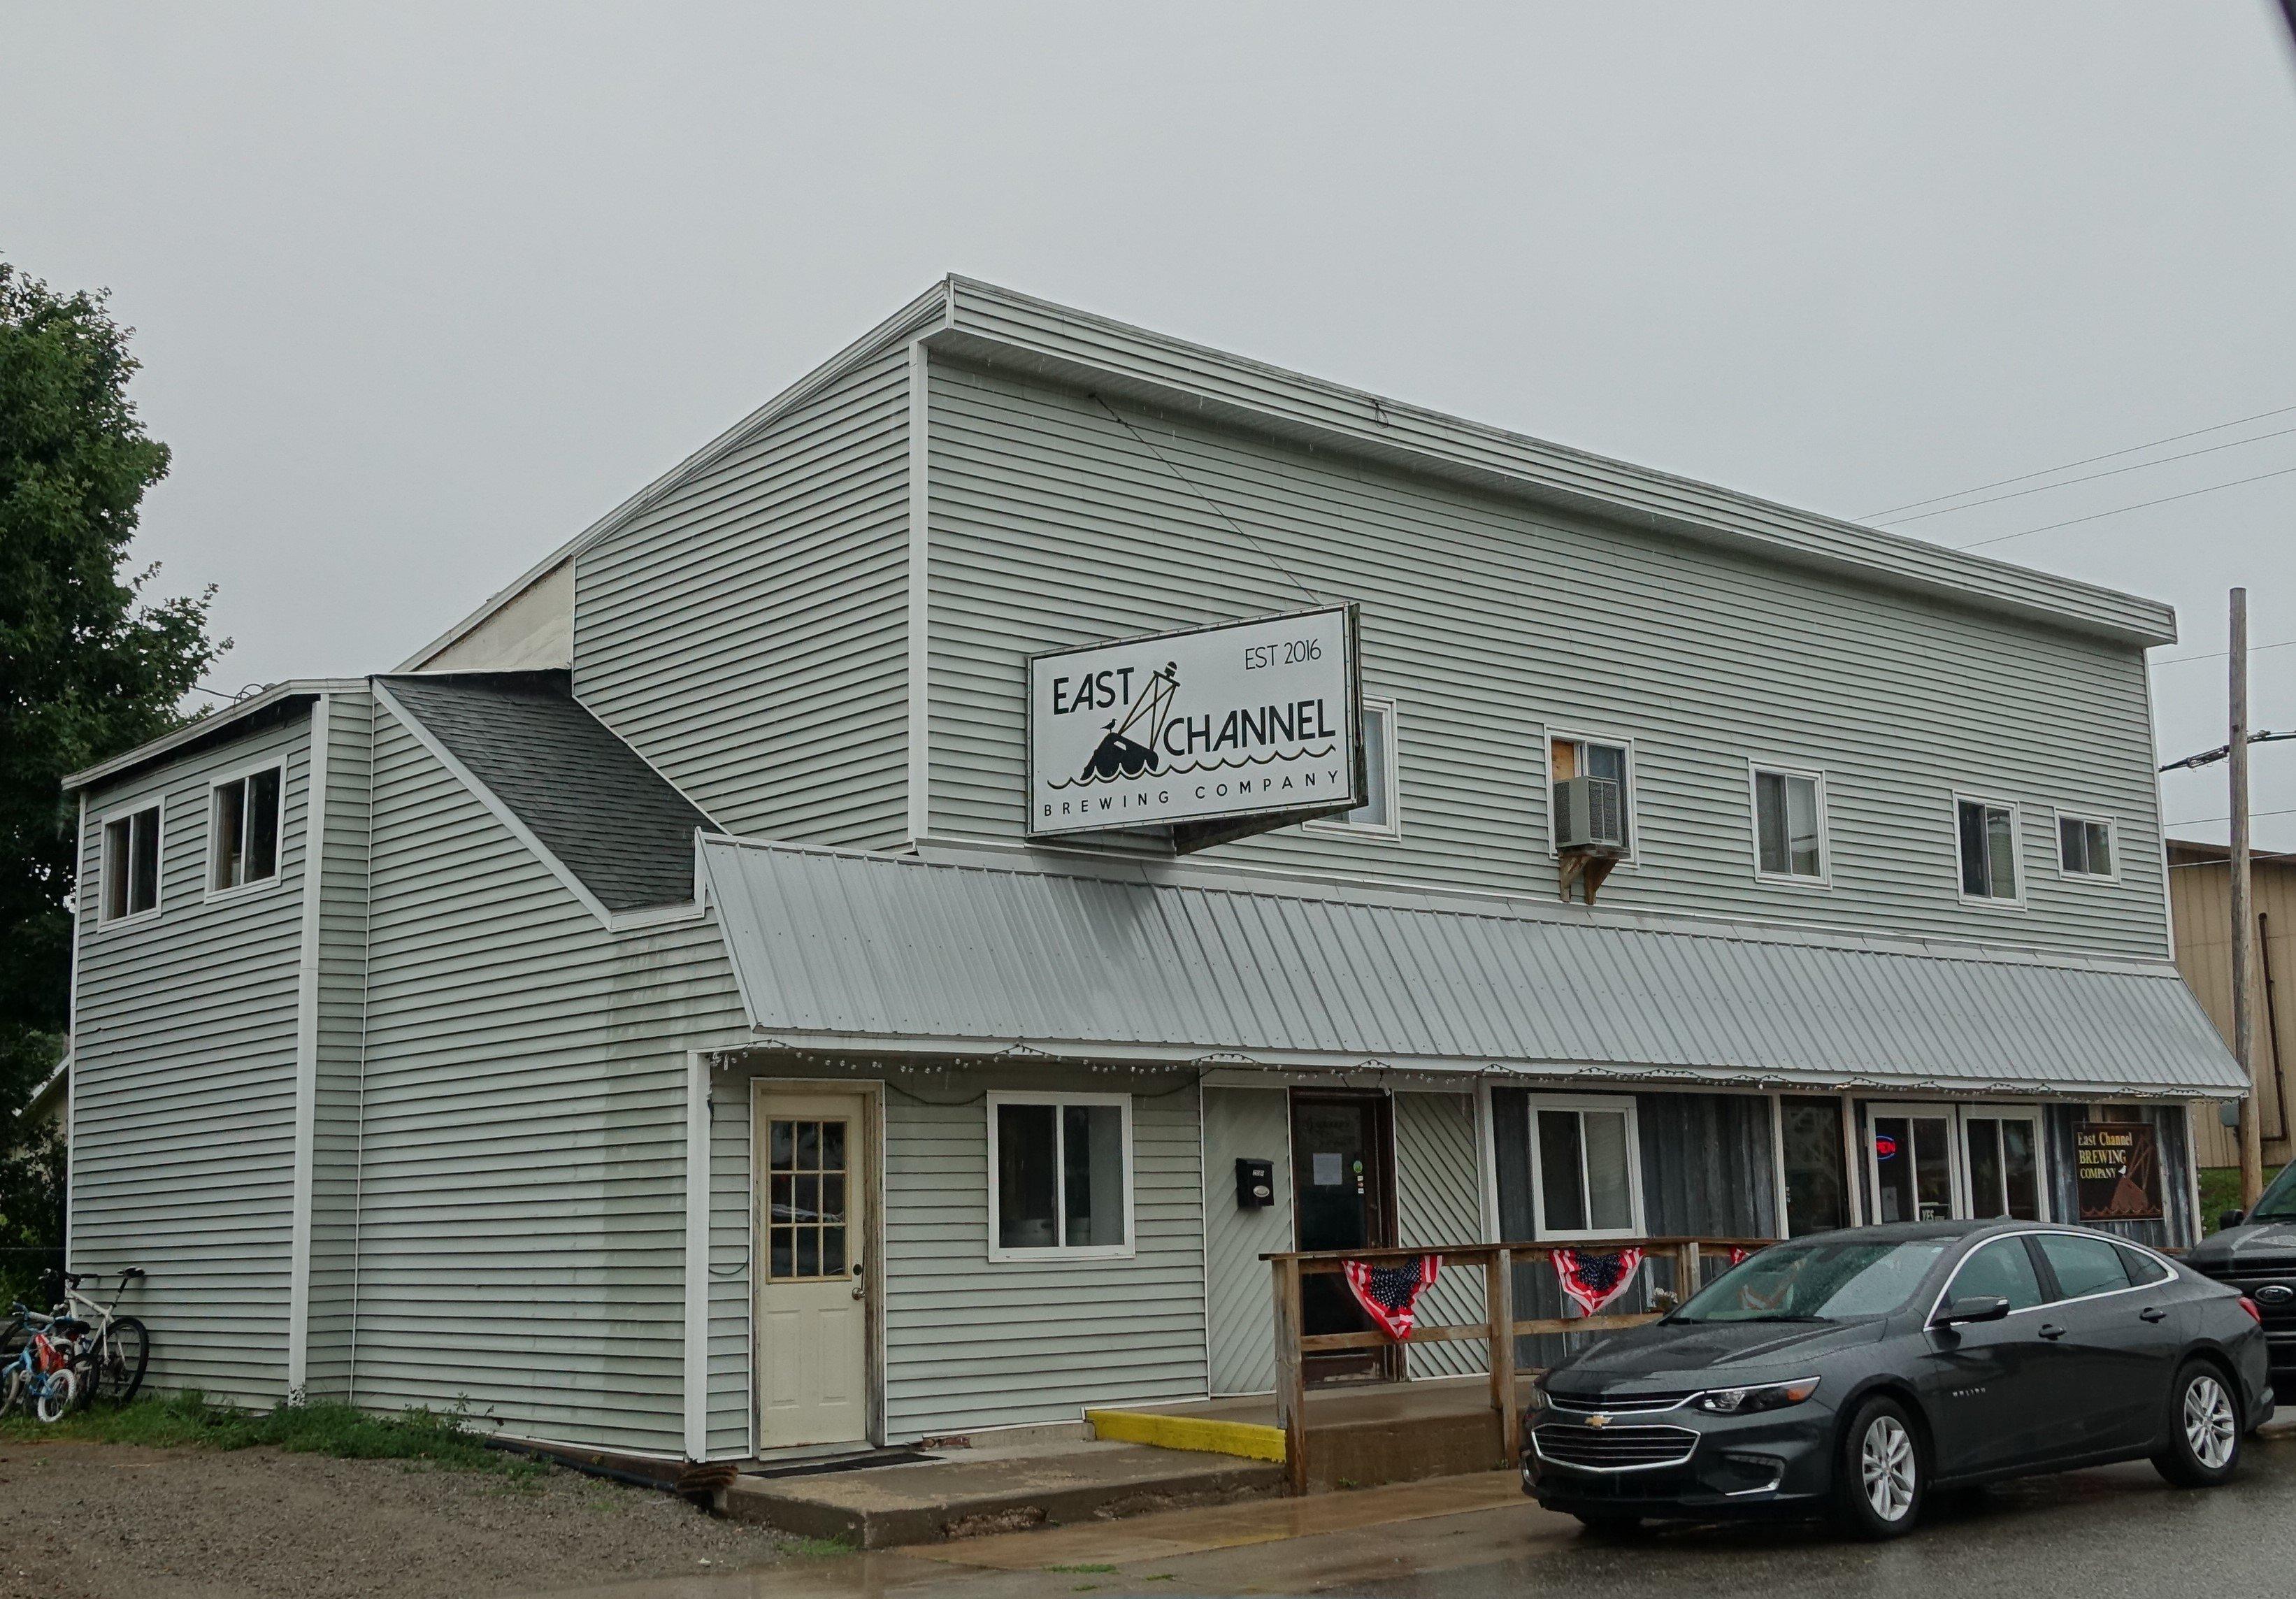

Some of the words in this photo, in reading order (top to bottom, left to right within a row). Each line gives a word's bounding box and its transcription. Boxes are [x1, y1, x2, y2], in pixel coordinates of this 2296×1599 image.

[1245, 644, 1278, 670] EST
[1284, 638, 1321, 664] 2016
[1053, 667, 1134, 715] EAST
[1163, 698, 1336, 757] CHANNEL
[1044, 791, 1169, 817] BREWING
[1195, 770, 1338, 799] COMPANY
[2077, 1131, 2096, 1146] East
[2099, 1131, 2132, 1146] Channel
[2079, 1149, 2126, 1164] BREWING
[2080, 1168, 2116, 1179] COMPANY
